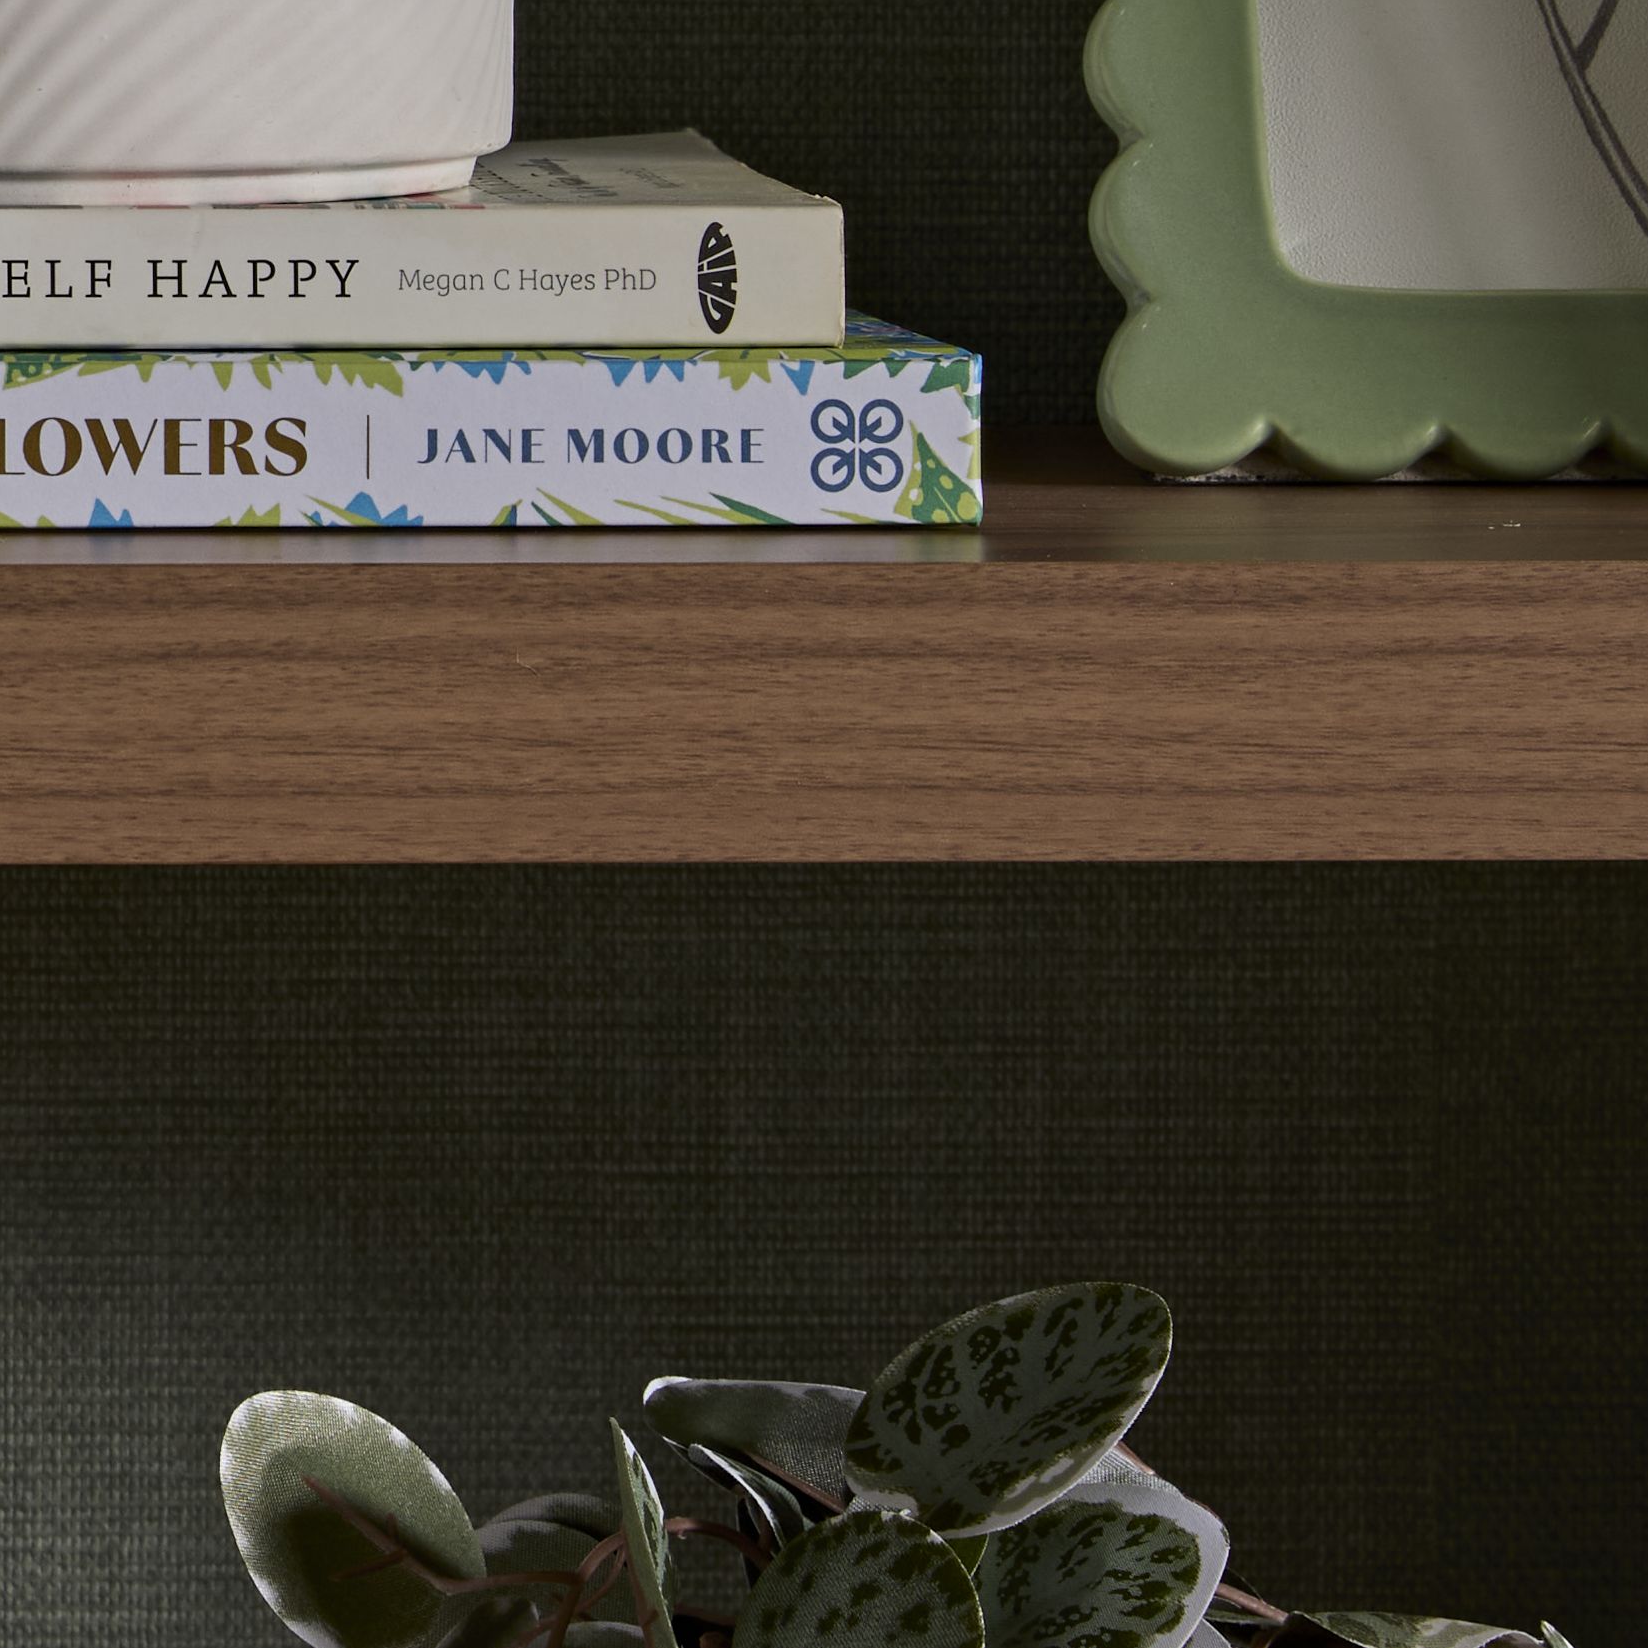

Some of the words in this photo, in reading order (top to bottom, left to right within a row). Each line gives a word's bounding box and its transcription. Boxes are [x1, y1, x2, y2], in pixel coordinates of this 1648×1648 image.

[146, 258, 361, 299] HAPPY
[397, 268, 485, 298] Megan
[493, 268, 511, 292] C
[518, 267, 596, 298] Hayes
[603, 267, 658, 292] PhD
[416, 427, 546, 465] JANE
[566, 426, 765, 465] MOORE
